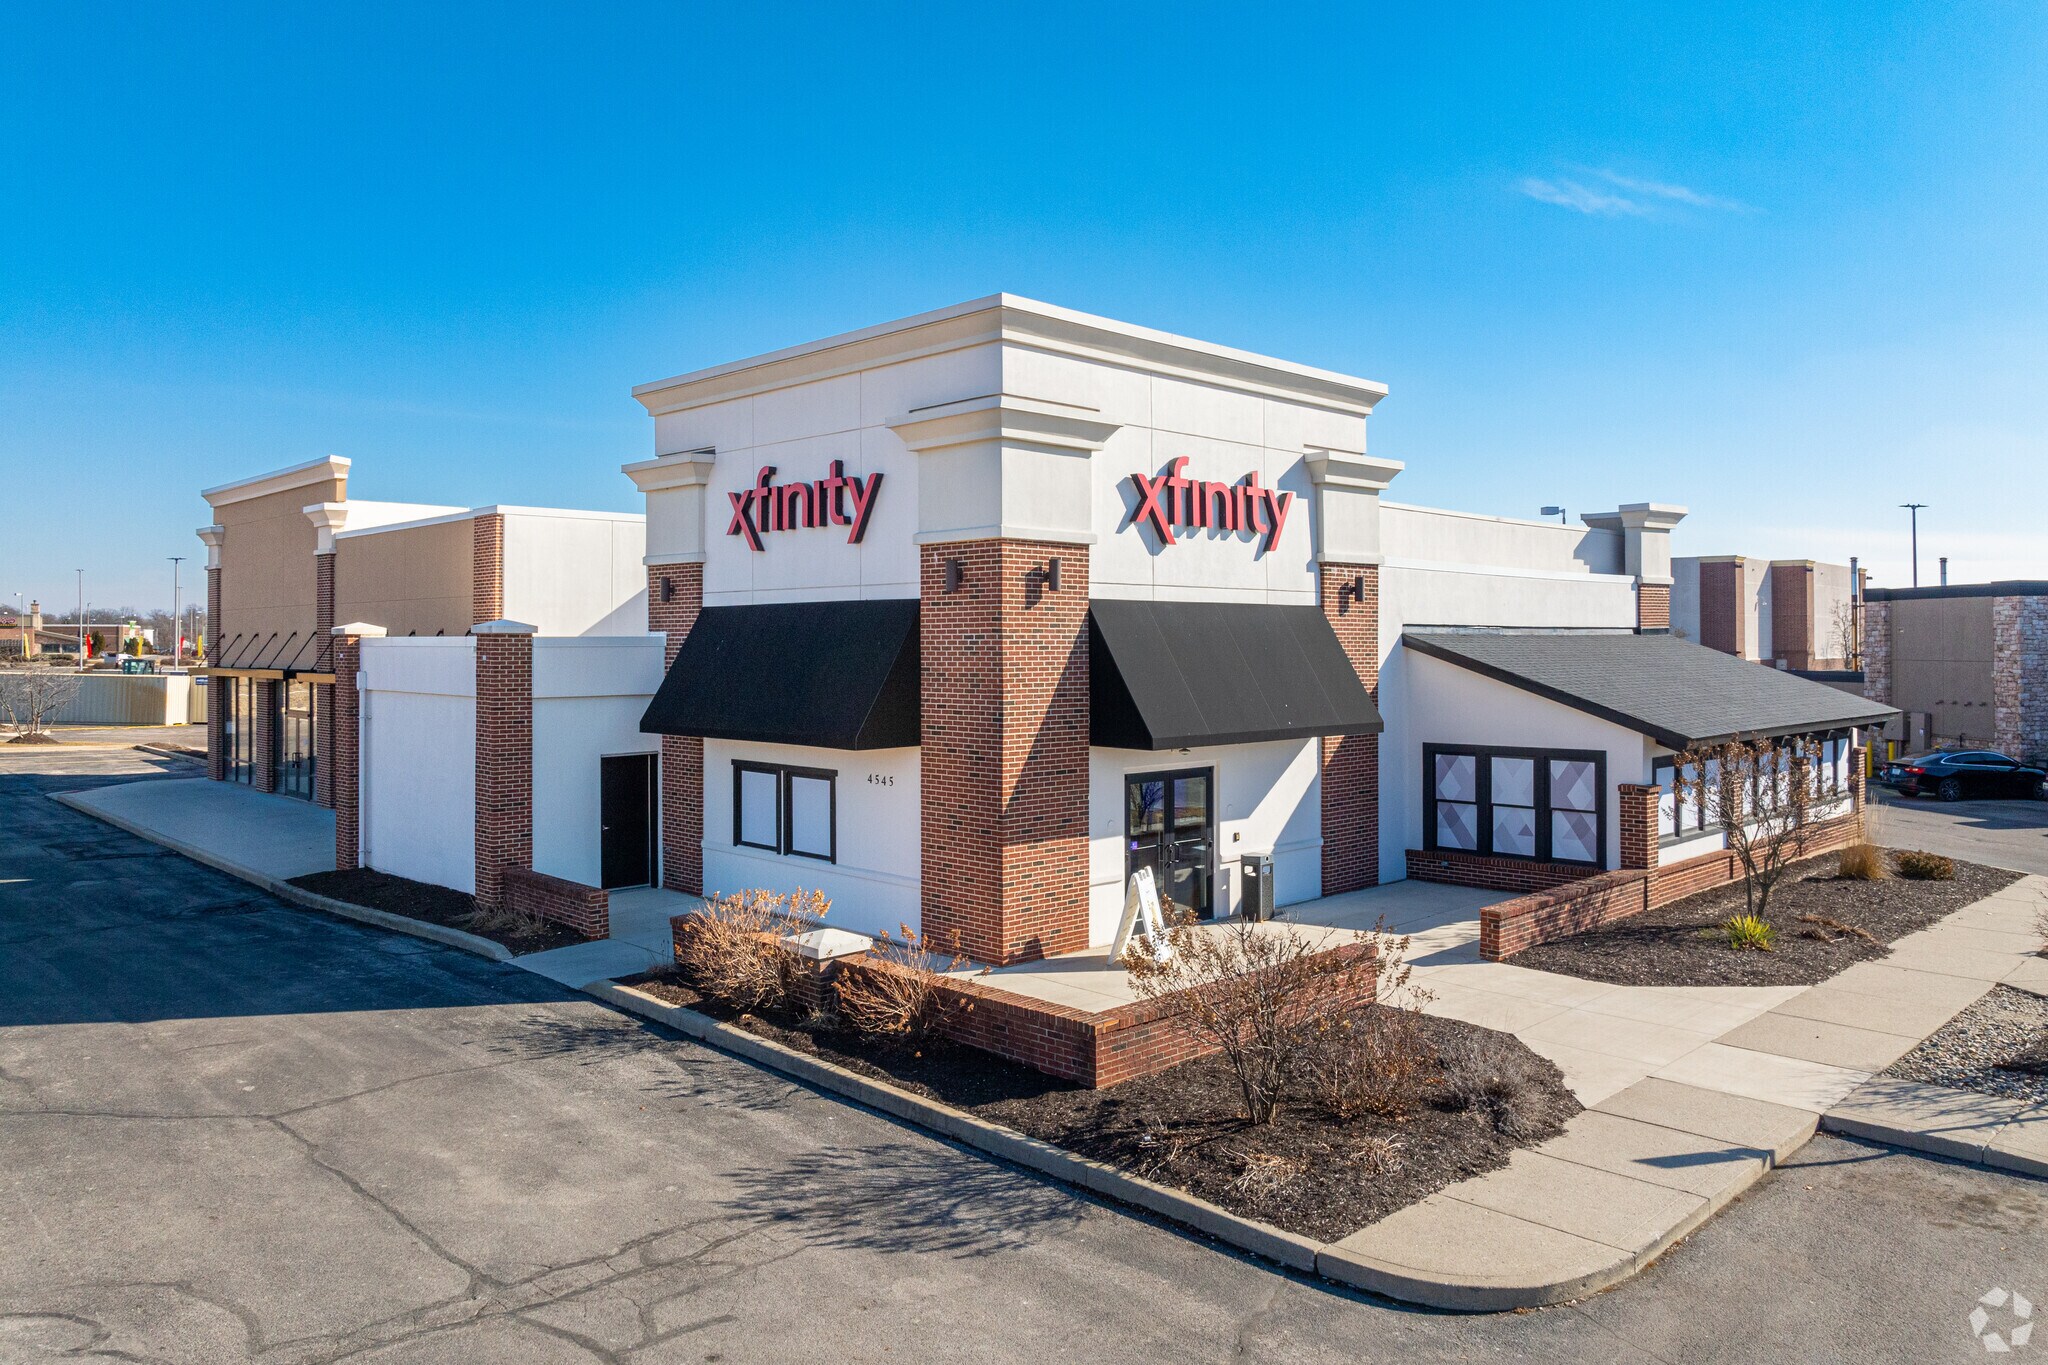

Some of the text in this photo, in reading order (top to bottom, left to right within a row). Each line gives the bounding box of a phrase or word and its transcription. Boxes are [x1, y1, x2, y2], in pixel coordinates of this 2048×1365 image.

[727, 460, 884, 551] xfinity
[1130, 456, 1293, 551] xfinity
[867, 773, 894, 787] 4545
